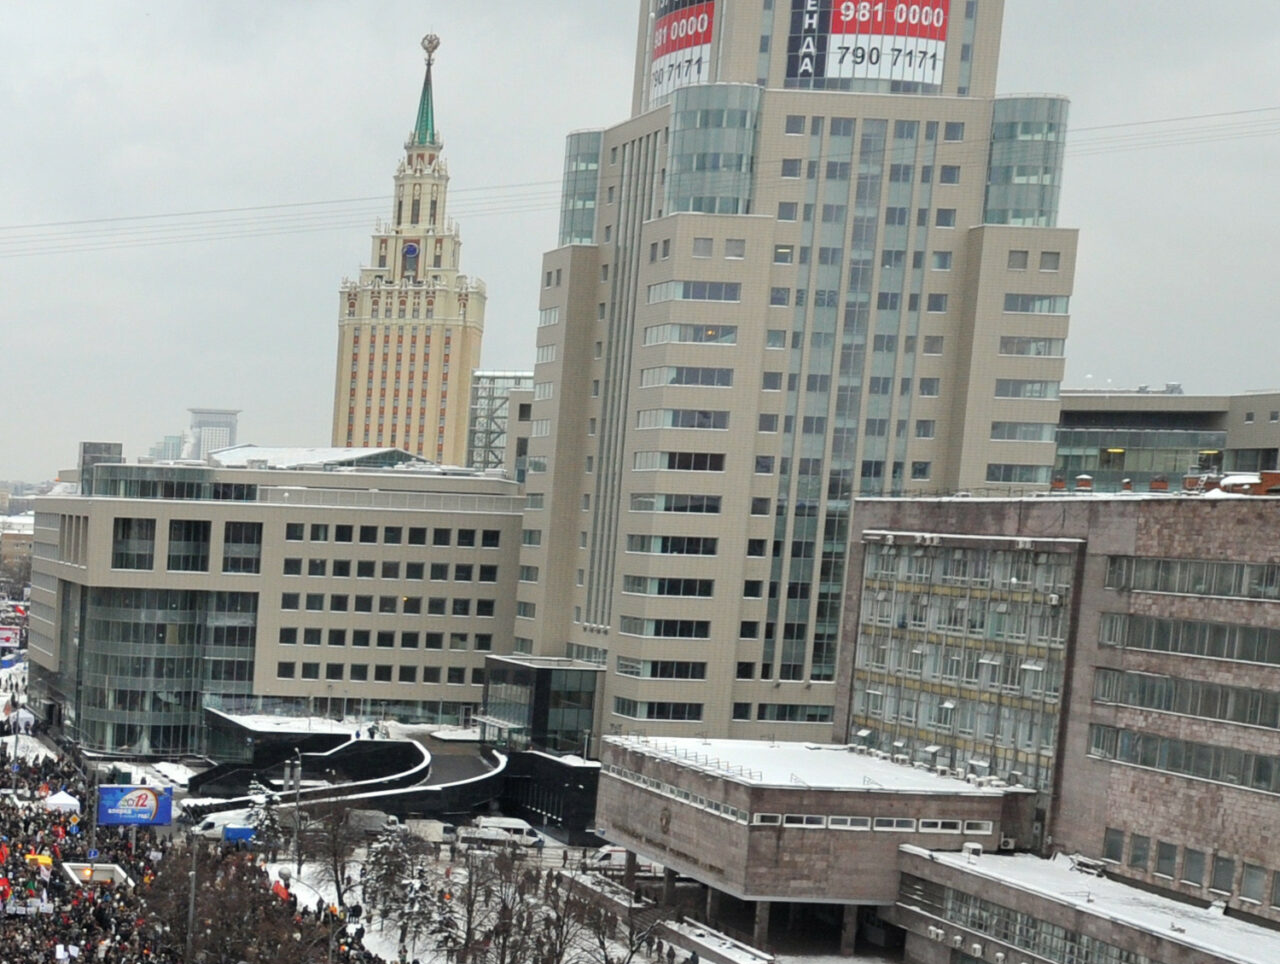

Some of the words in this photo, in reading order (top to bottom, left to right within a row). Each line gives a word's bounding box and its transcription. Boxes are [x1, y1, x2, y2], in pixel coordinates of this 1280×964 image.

[670, 13, 709, 41] 0000
[840, 2, 883, 23] 981
[894, 3, 944, 28] 0000
[668, 56, 703, 83] 7171
[837, 46, 880, 66] 790
[891, 48, 938, 71] 7171
